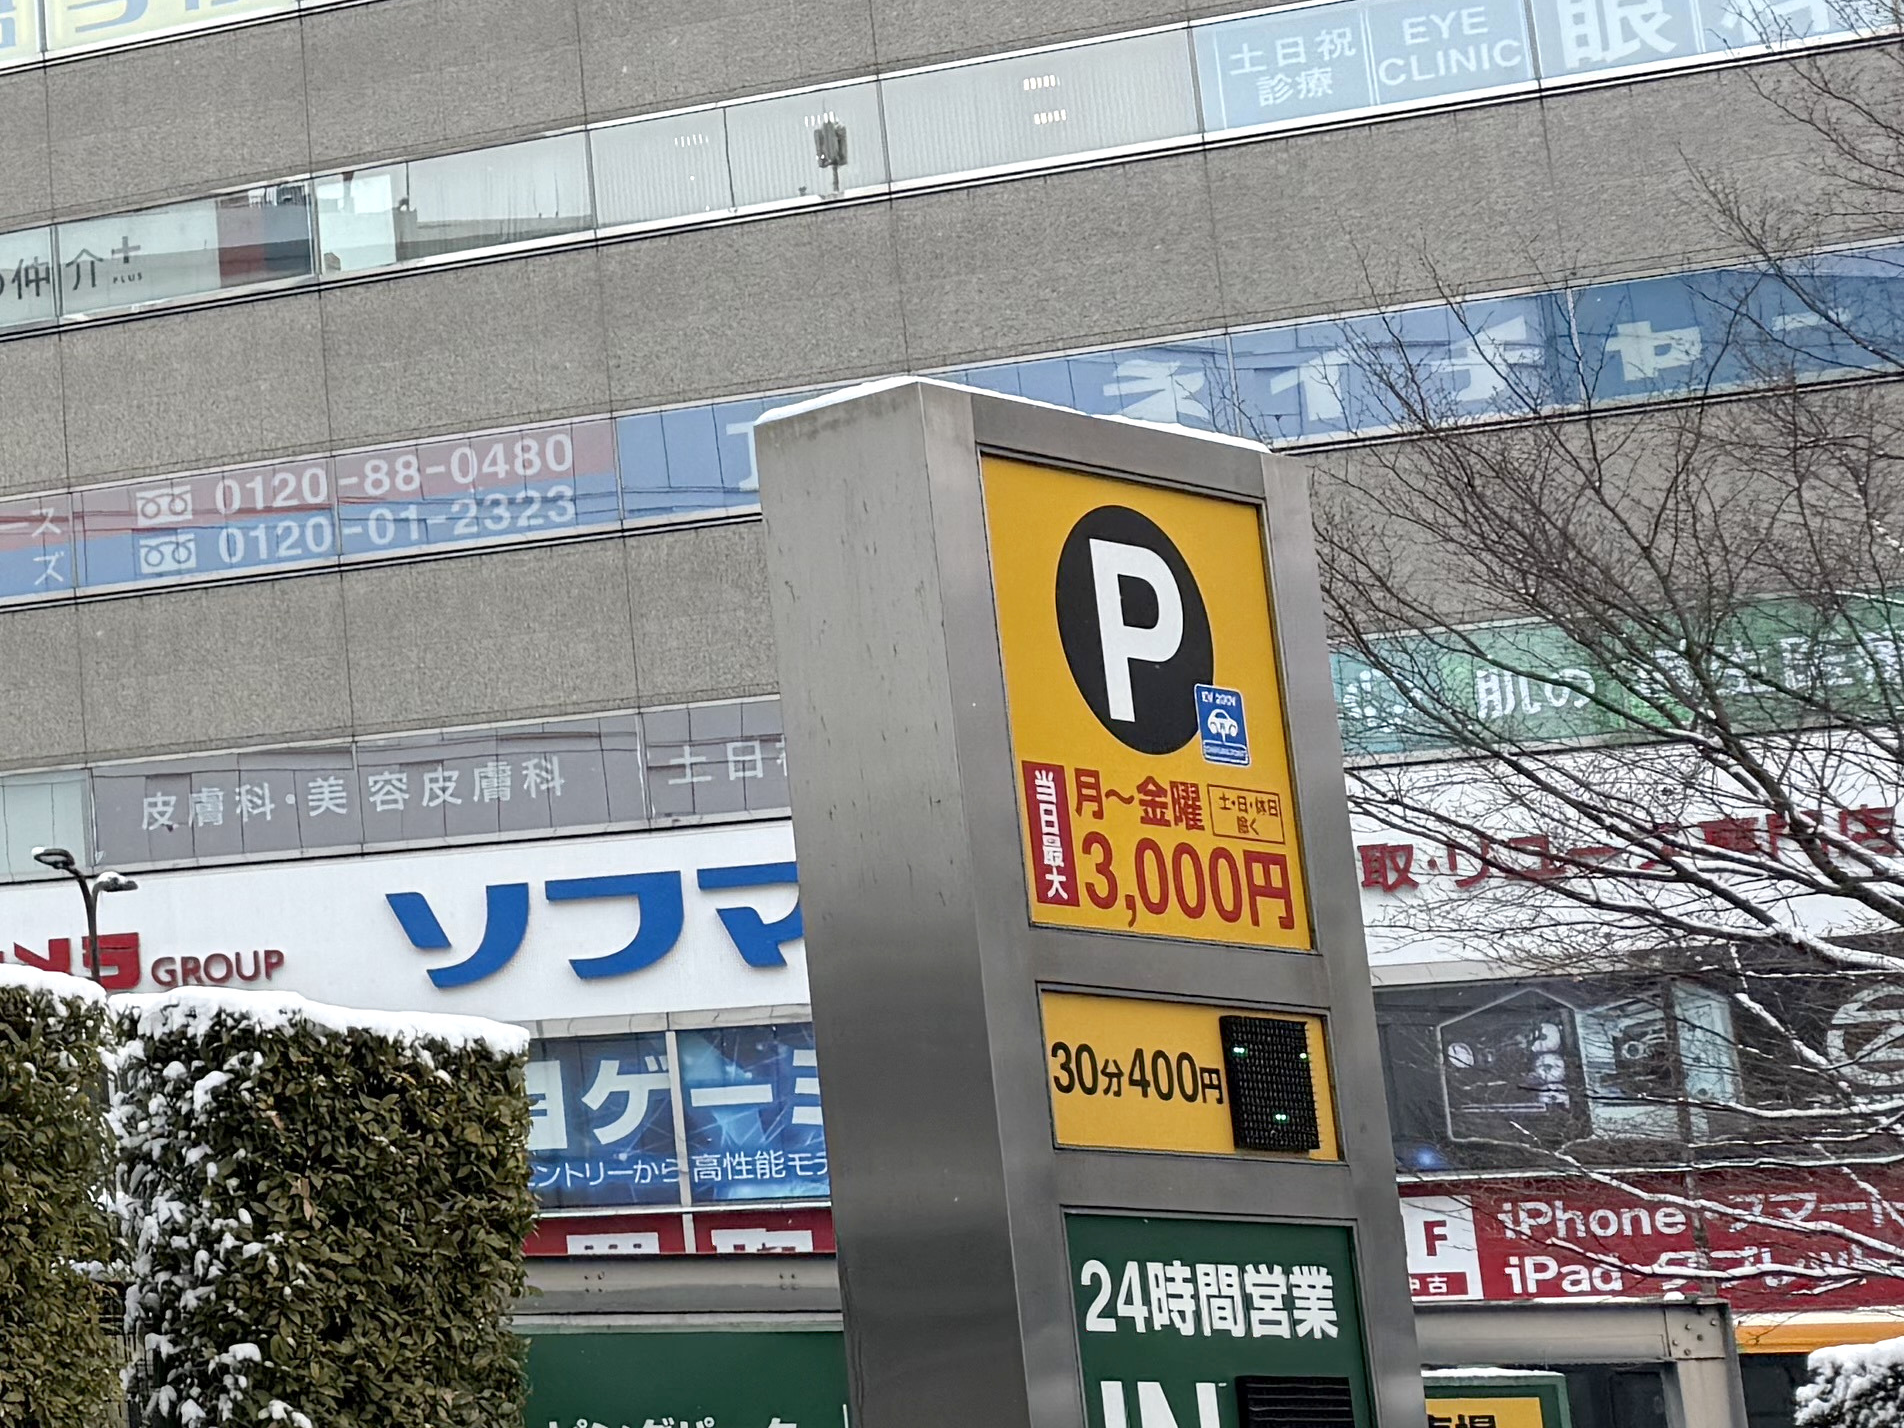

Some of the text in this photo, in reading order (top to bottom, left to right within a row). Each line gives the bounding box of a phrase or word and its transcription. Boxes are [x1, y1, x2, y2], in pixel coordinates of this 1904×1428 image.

[1228, 26, 1357, 77] 土日祝
[1403, 5, 1489, 45] EYE
[1257, 73, 1334, 108] 診療
[1378, 36, 1523, 88] CLINIC
[112, 271, 144, 285] PLUS
[214, 432, 574, 515] 0120-88-0480
[219, 486, 577, 565] 0120-01-2323
[1088, 537, 1184, 723] P
[140, 754, 567, 833] 皮膚科・美容皮膚科
[1032, 768, 1070, 902] 当日最大
[1081, 831, 1295, 930] 3,000円
[151, 949, 285, 988] GROUP
[1051, 1040, 1225, 1105] 30分400円
[1498, 1200, 1687, 1241] iPhone
[1080, 1259, 1339, 1339] 24時間営業
[1504, 1253, 1625, 1296] iPad
